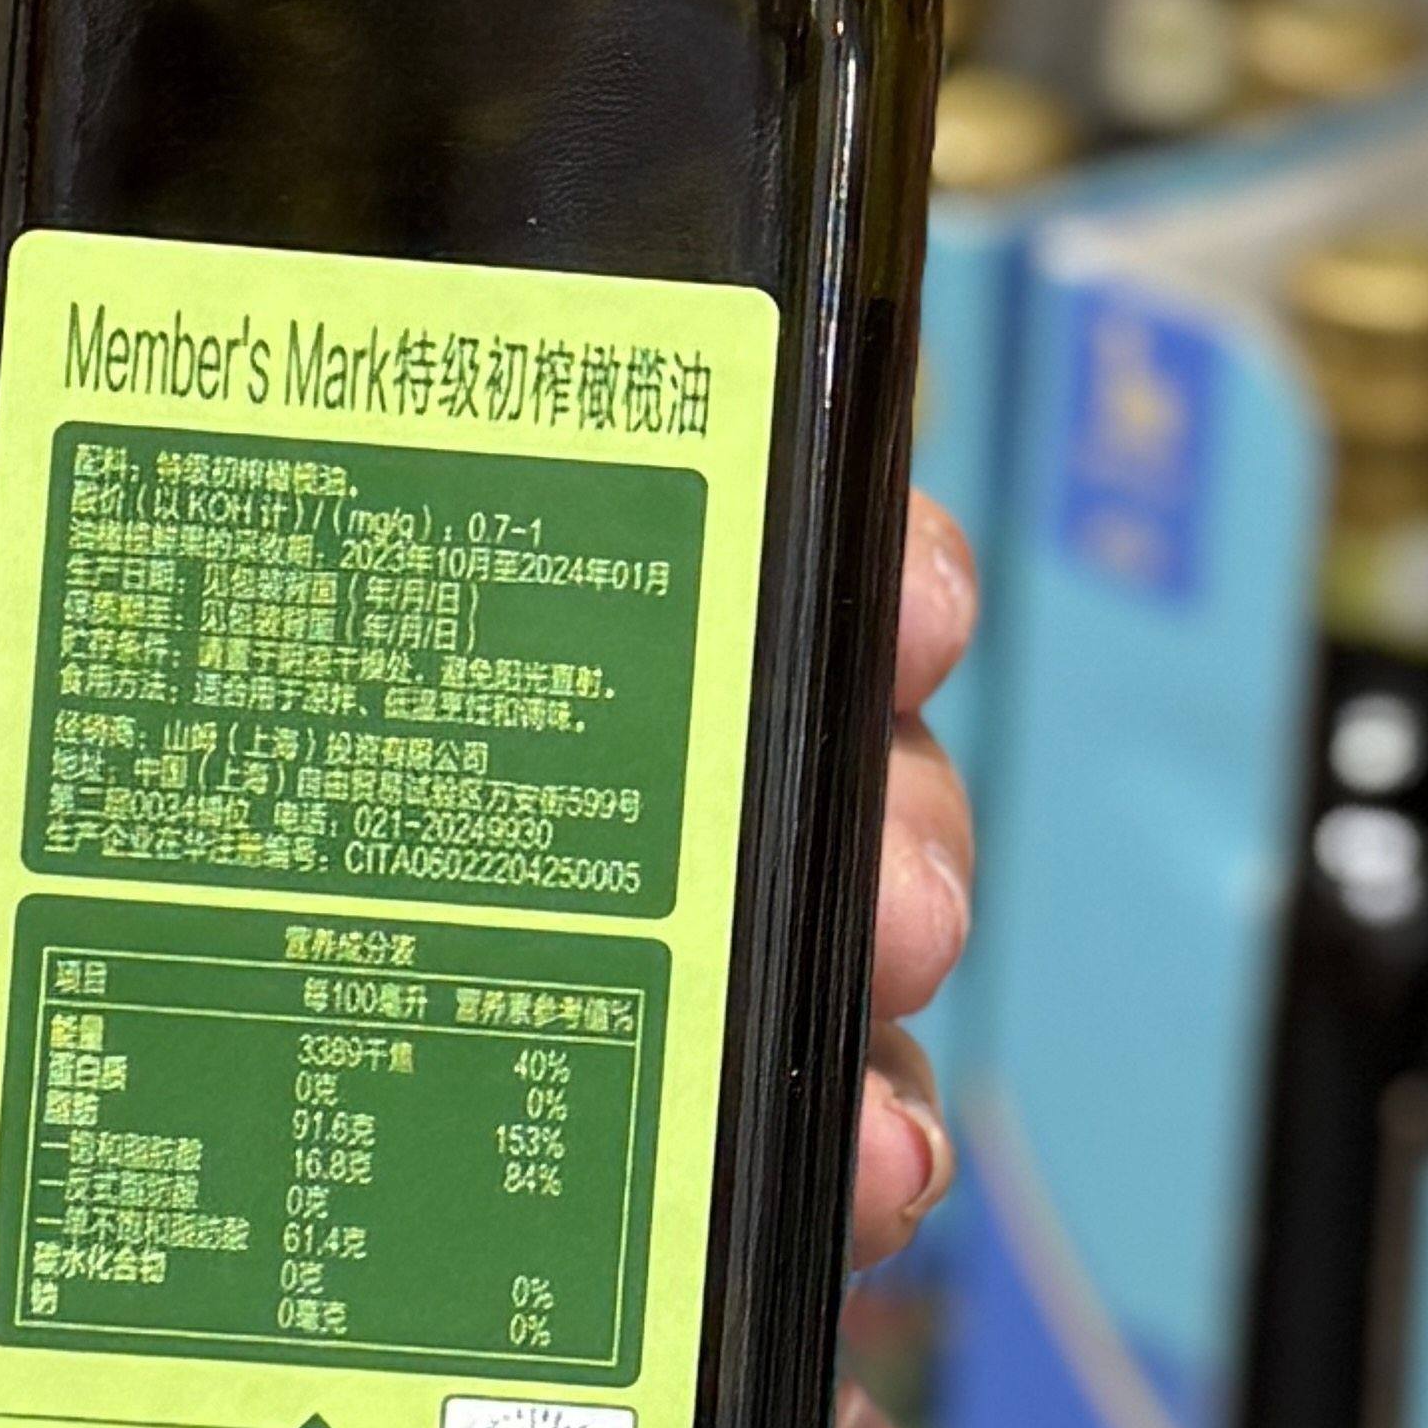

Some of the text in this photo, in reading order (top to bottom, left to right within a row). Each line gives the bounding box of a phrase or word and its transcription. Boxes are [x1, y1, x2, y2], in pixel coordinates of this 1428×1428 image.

[64, 301, 712, 439] Member's Mark特级初榨橄榄油
[297, 1033, 414, 1074] 3389千焦
[513, 1048, 572, 1084] 40%
[294, 1069, 340, 1108] 0克
[526, 1086, 569, 1122] 0%
[292, 1108, 376, 1148] 91.6克
[495, 1123, 566, 1160] 153%
[294, 1147, 374, 1185] 16.8克
[503, 1161, 563, 1197] 84%
[285, 1184, 331, 1220] 0克
[283, 1221, 368, 1260] 61.4克
[279, 1258, 325, 1295] 0克
[511, 1274, 555, 1310] 0%
[277, 1296, 348, 1335] 0毫克
[509, 1312, 552, 1347] 0%
